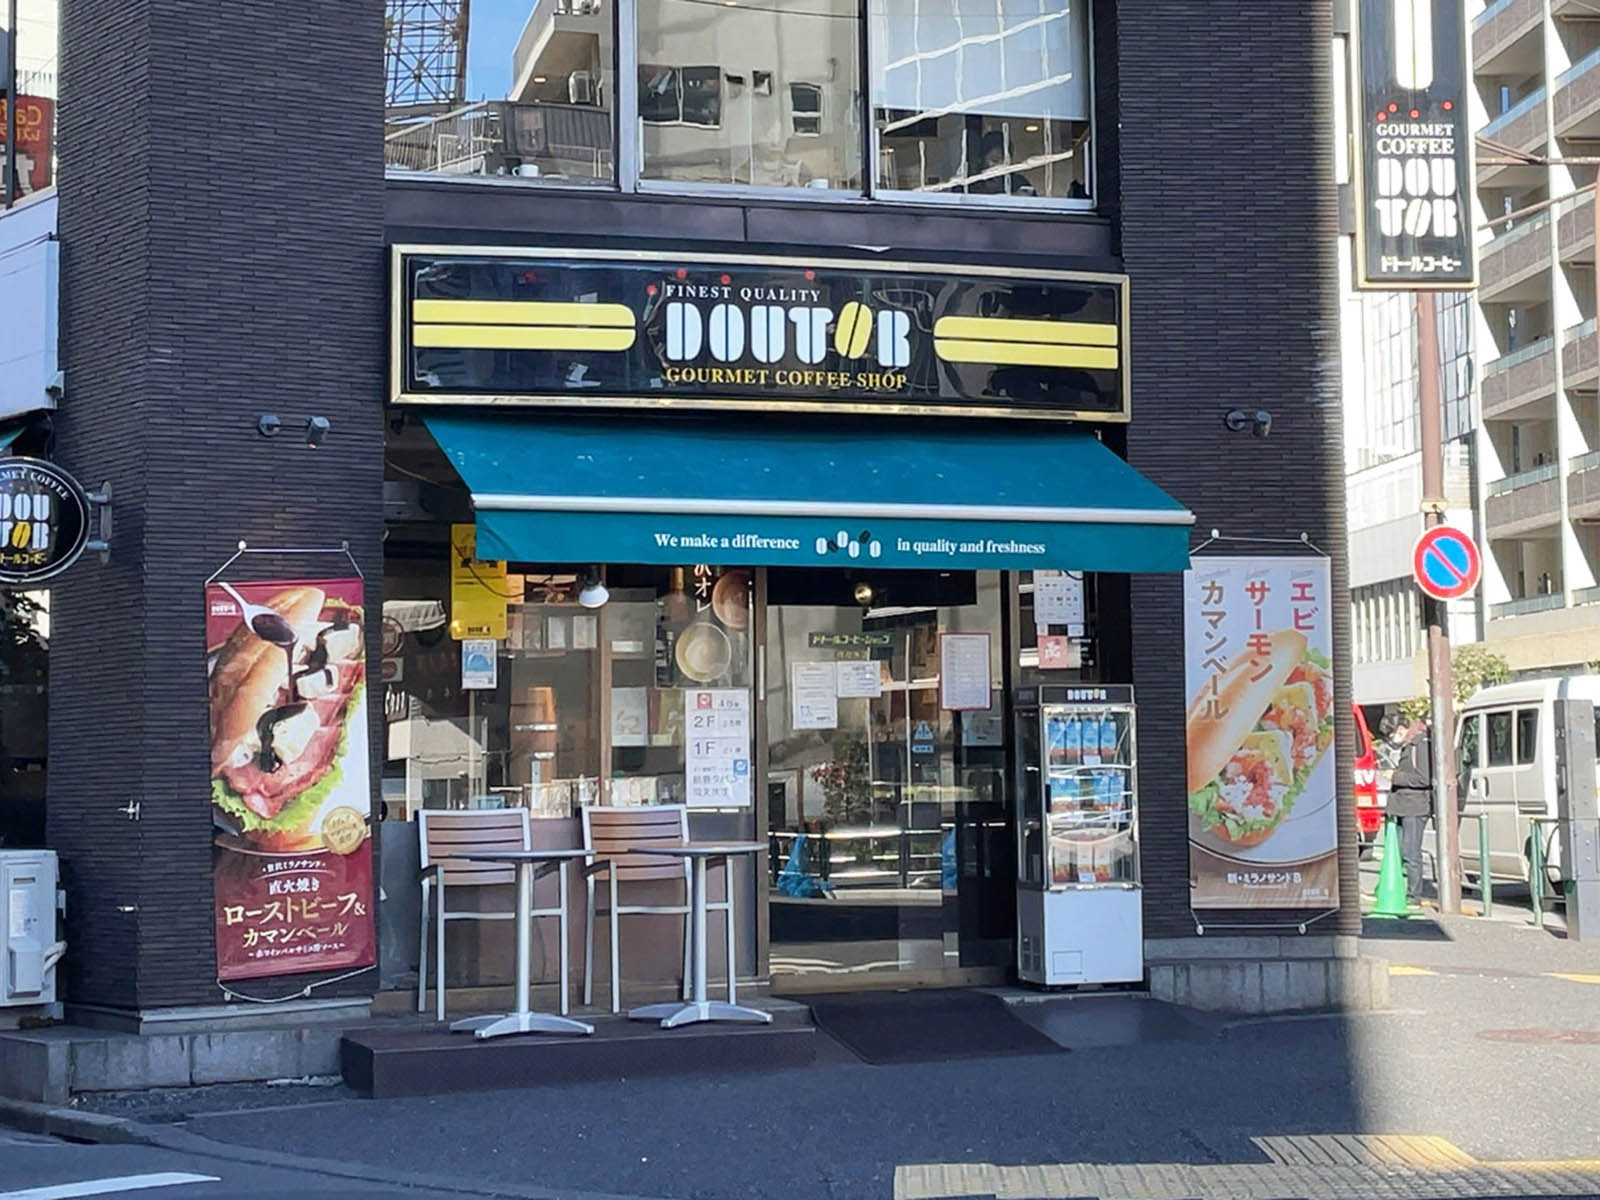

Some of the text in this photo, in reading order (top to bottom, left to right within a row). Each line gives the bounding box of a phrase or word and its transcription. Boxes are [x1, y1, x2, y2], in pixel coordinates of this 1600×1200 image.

[1376, 123, 1455, 137] GOURMET
[1376, 138, 1455, 155] COFFEE
[1378, 158, 1456, 197] DOU
[1375, 198, 1458, 237] TOR
[1381, 255, 1462, 272] ドトールコーヒー
[666, 285, 821, 302] FINEST QUALITY
[666, 301, 911, 367] DOUTOR
[666, 367, 907, 389] GOURMET COFFEE SHOP
[654, 533, 1046, 556] We make a difference in quality and freshness
[1290, 582, 1319, 631] エビ
[1245, 580, 1273, 683] サーモン
[1201, 580, 1229, 719] カマンベール
[694, 715, 715, 728] 2F
[694, 741, 715, 755] 1F
[242, 922, 349, 948] カマンベール
